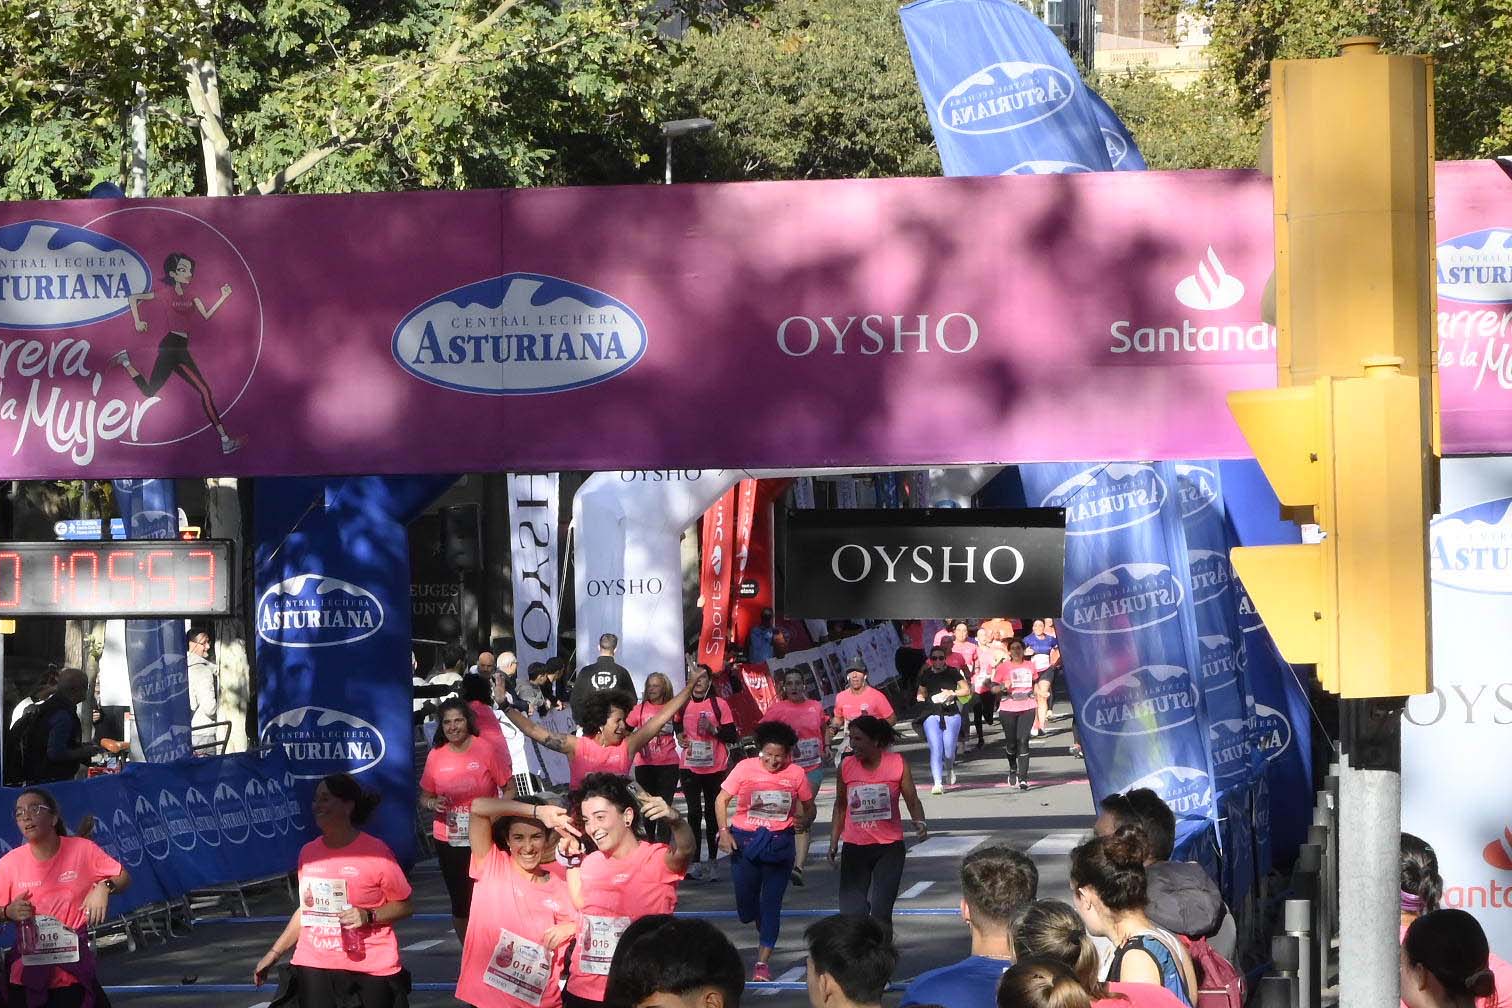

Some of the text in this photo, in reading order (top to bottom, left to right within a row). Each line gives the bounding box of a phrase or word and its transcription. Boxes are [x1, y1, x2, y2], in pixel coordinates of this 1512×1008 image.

[54, 256, 127, 269] LECHERA
[451, 313, 619, 330] CENTRAL LECHERA
[776, 312, 979, 357] OYSHO
[1110, 319, 1276, 353] Santand
[412, 321, 627, 366] ASTURIANA
[12, 373, 161, 466] Mujer
[831, 544, 1025, 585] OYSHO
[587, 577, 663, 597] OYSHO
[261, 603, 375, 632] ASTURIANA
[706, 579, 725, 656] Sports
[1403, 682, 1512, 726] OYS
[316, 897, 331, 906] 016
[40, 932, 59, 942] 016
[591, 939, 609, 949] 016
[512, 959, 533, 975] 016
